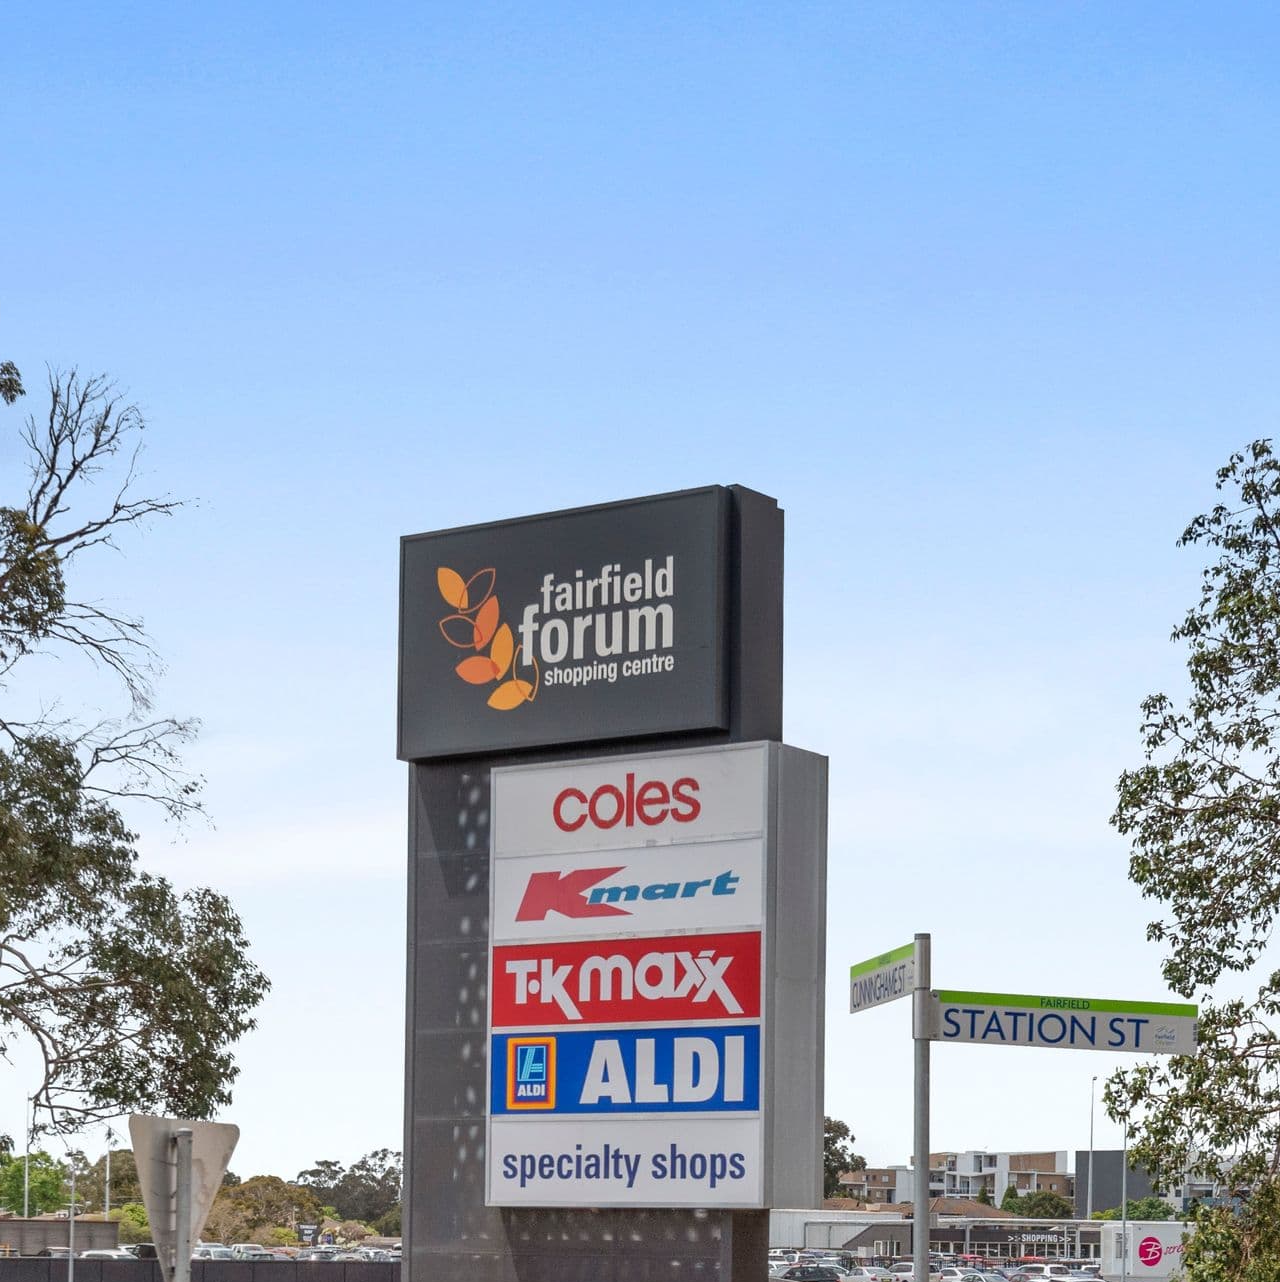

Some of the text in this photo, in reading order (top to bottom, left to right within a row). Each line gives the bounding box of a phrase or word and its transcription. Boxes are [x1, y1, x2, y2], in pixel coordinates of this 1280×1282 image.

[540, 555, 674, 614] fairfield
[518, 602, 674, 666] forum
[544, 653, 674, 687] shopping centre
[552, 772, 702, 832] coles
[514, 864, 740, 922] Kmart
[852, 966, 898, 1009] CUNNINGHAME
[1040, 997, 1090, 1010] FAIRFIELD
[943, 1008, 1149, 1049] STATION ST
[517, 1084, 546, 1097] ALDI
[580, 1036, 745, 1105] ALDI
[502, 1144, 746, 1188] specialty shops
[1021, 1233, 1058, 1242] SHOPPING
